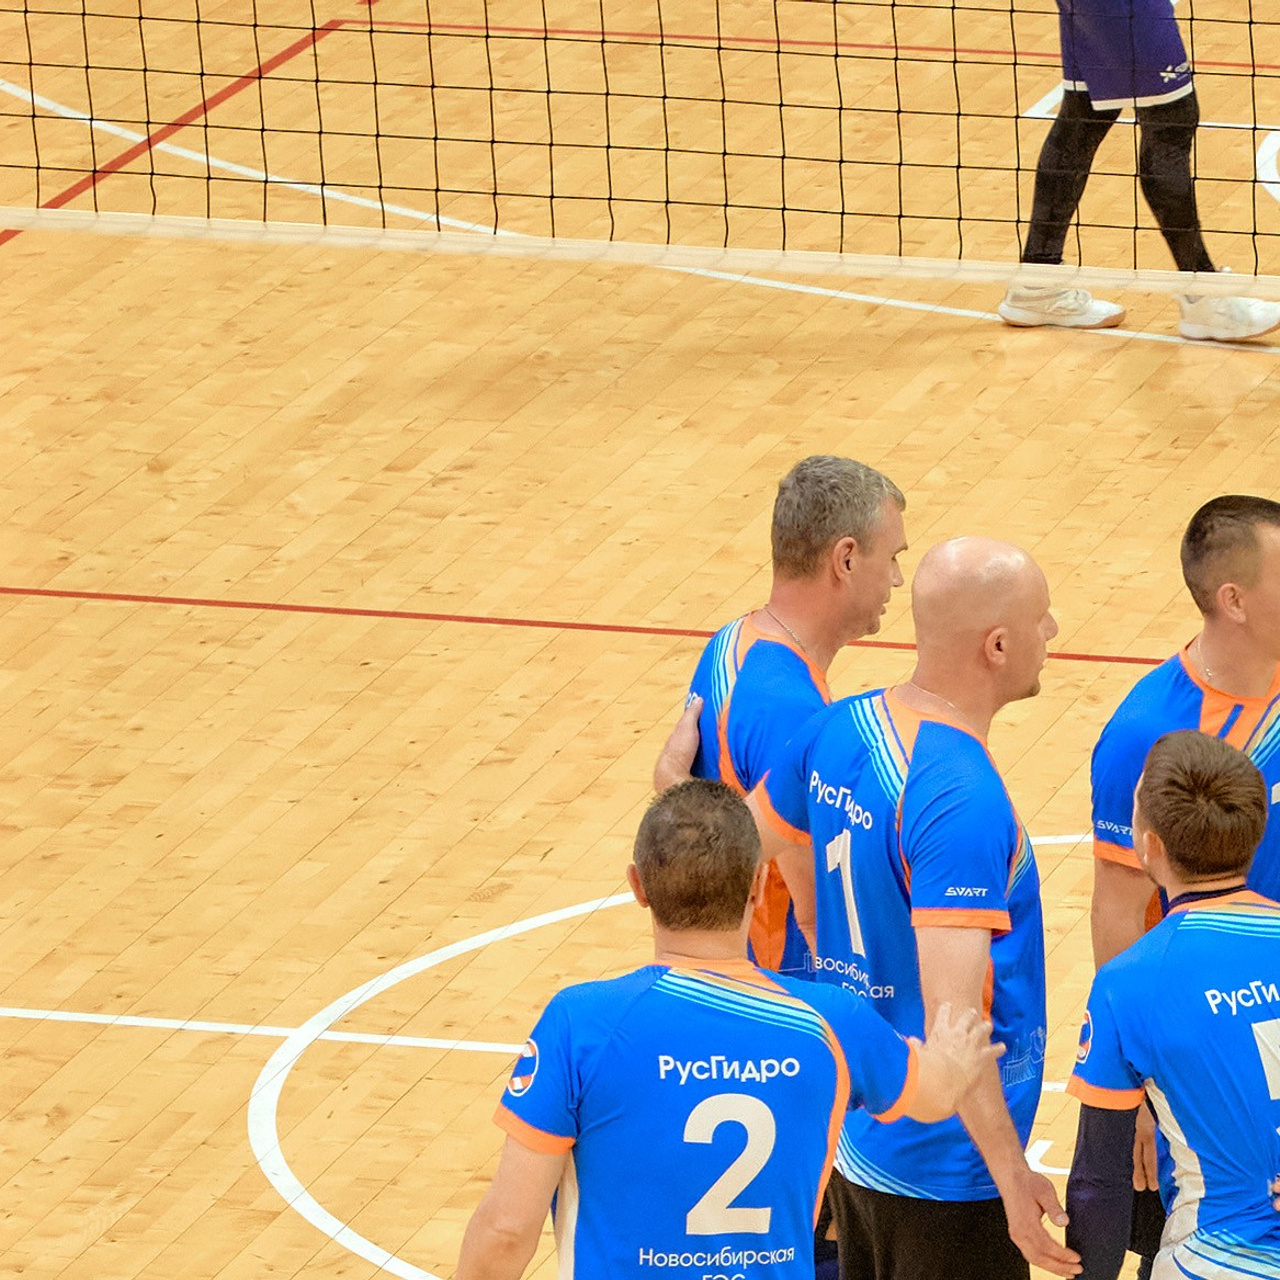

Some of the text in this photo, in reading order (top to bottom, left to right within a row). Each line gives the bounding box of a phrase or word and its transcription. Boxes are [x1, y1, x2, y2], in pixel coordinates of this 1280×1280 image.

[826, 828, 865, 958] 1
[944, 886, 988, 897] SVART
[659, 1055, 800, 1085] РусГидро
[683, 1093, 776, 1235] 2
[638, 1246, 795, 1269] Новосибирская
